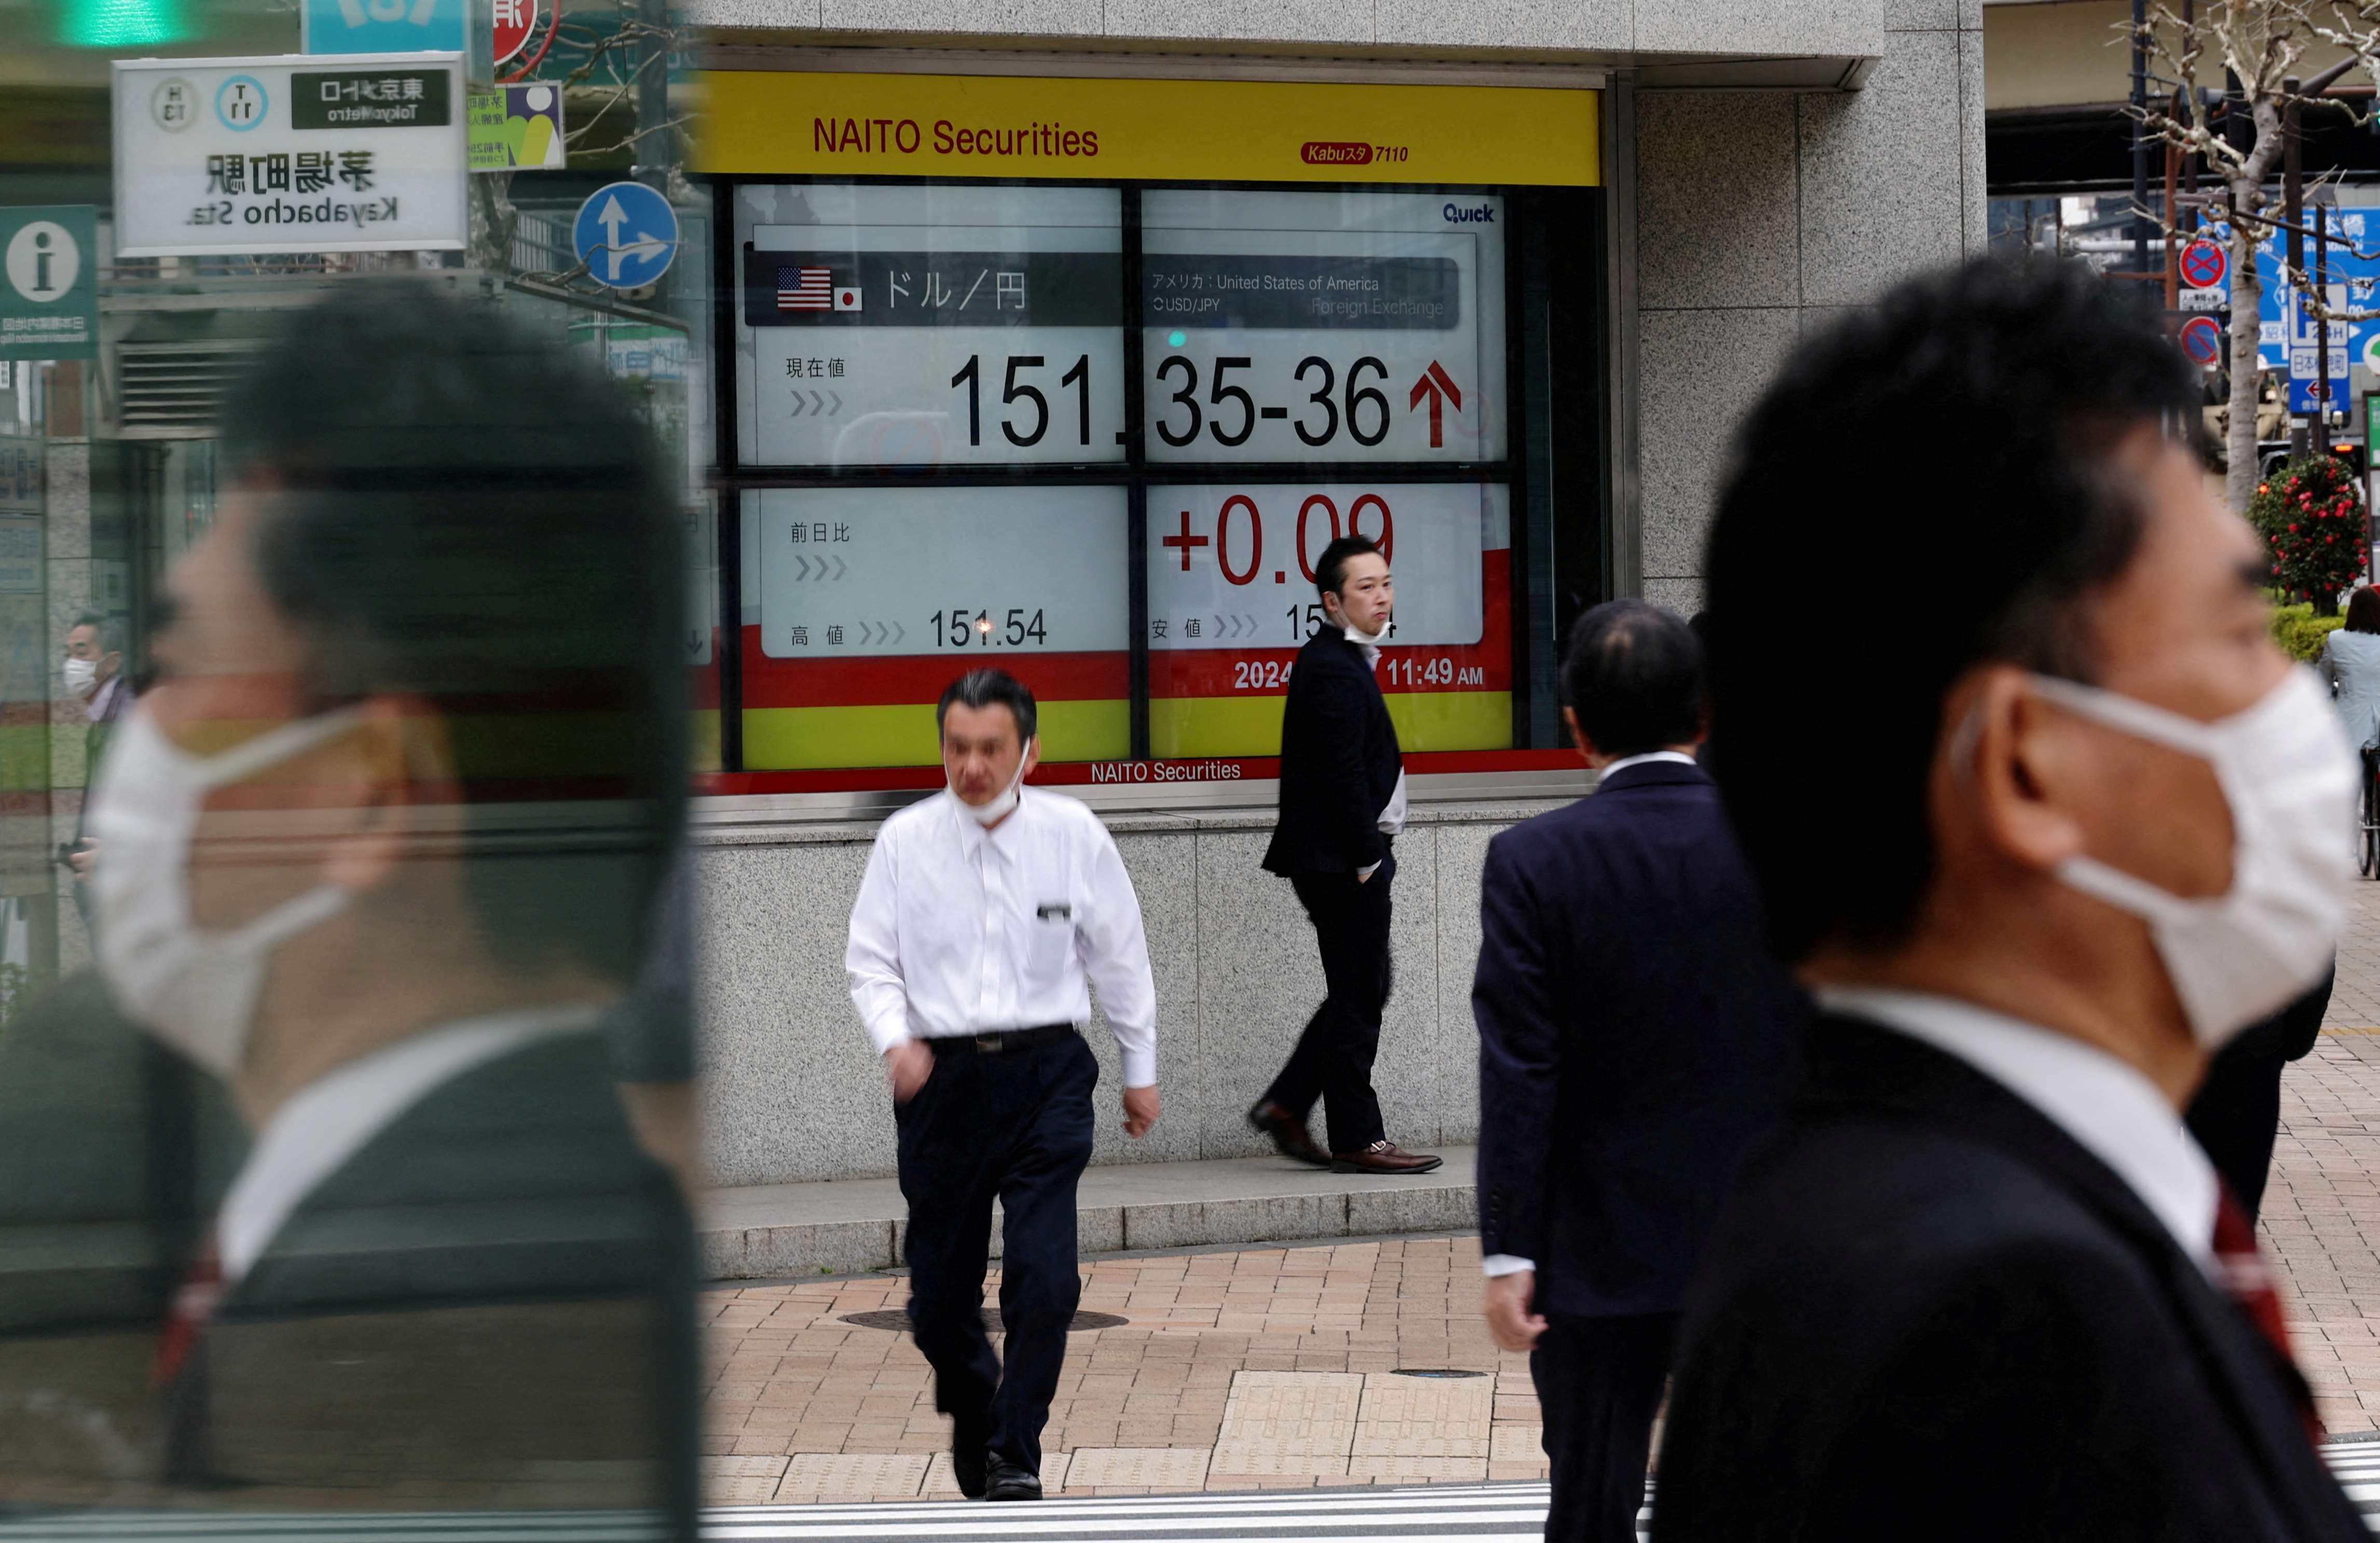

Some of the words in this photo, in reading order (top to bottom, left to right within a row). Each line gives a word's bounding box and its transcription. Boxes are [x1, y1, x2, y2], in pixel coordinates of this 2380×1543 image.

[814, 118, 921, 154] NAITO
[934, 120, 1099, 156] Securities
[1376, 146, 1409, 162] 7110
[1218, 274, 1259, 290] United
[1264, 275, 1304, 291] States
[1309, 277, 1322, 291] of
[1327, 277, 1379, 292] America
[1312, 298, 1368, 318] Foreign
[1372, 299, 1443, 318] Exchange
[786, 357, 846, 378] 現在値
[791, 522, 850, 543] 前日比
[791, 625, 844, 646] 高値
[931, 609, 1047, 647] 151.54
[1152, 617, 1202, 639] 安値
[1387, 658, 1453, 685] 11:49
[1457, 667, 1483, 685] AM
[1092, 763, 1148, 783] NAITO
[1154, 761, 1241, 781] Securities
